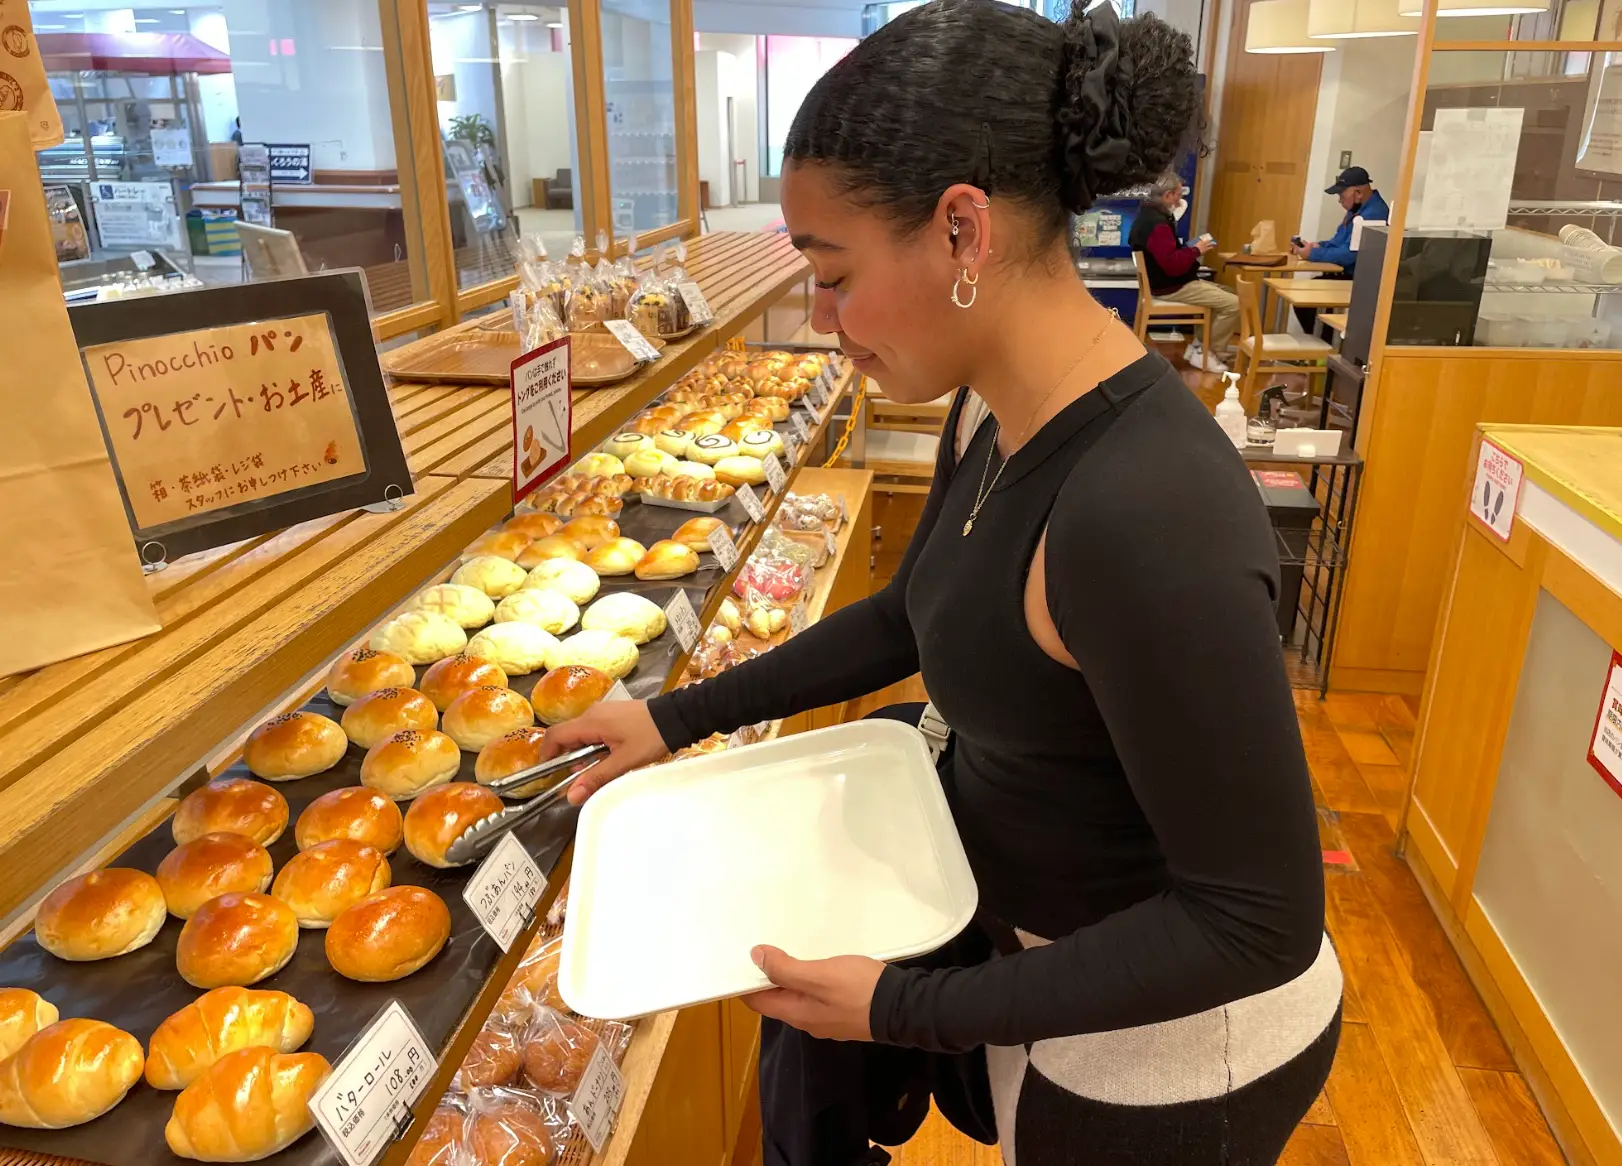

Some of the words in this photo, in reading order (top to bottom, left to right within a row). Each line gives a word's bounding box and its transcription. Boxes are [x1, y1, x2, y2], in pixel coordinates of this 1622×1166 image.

[104, 341, 233, 386] Pinocchio
[250, 330, 303, 356] パン
[186, 462, 322, 511] スタッフにお申しつけ下さい
[480, 862, 515, 909] つぶあんパン
[336, 1050, 392, 1121] バターロール
